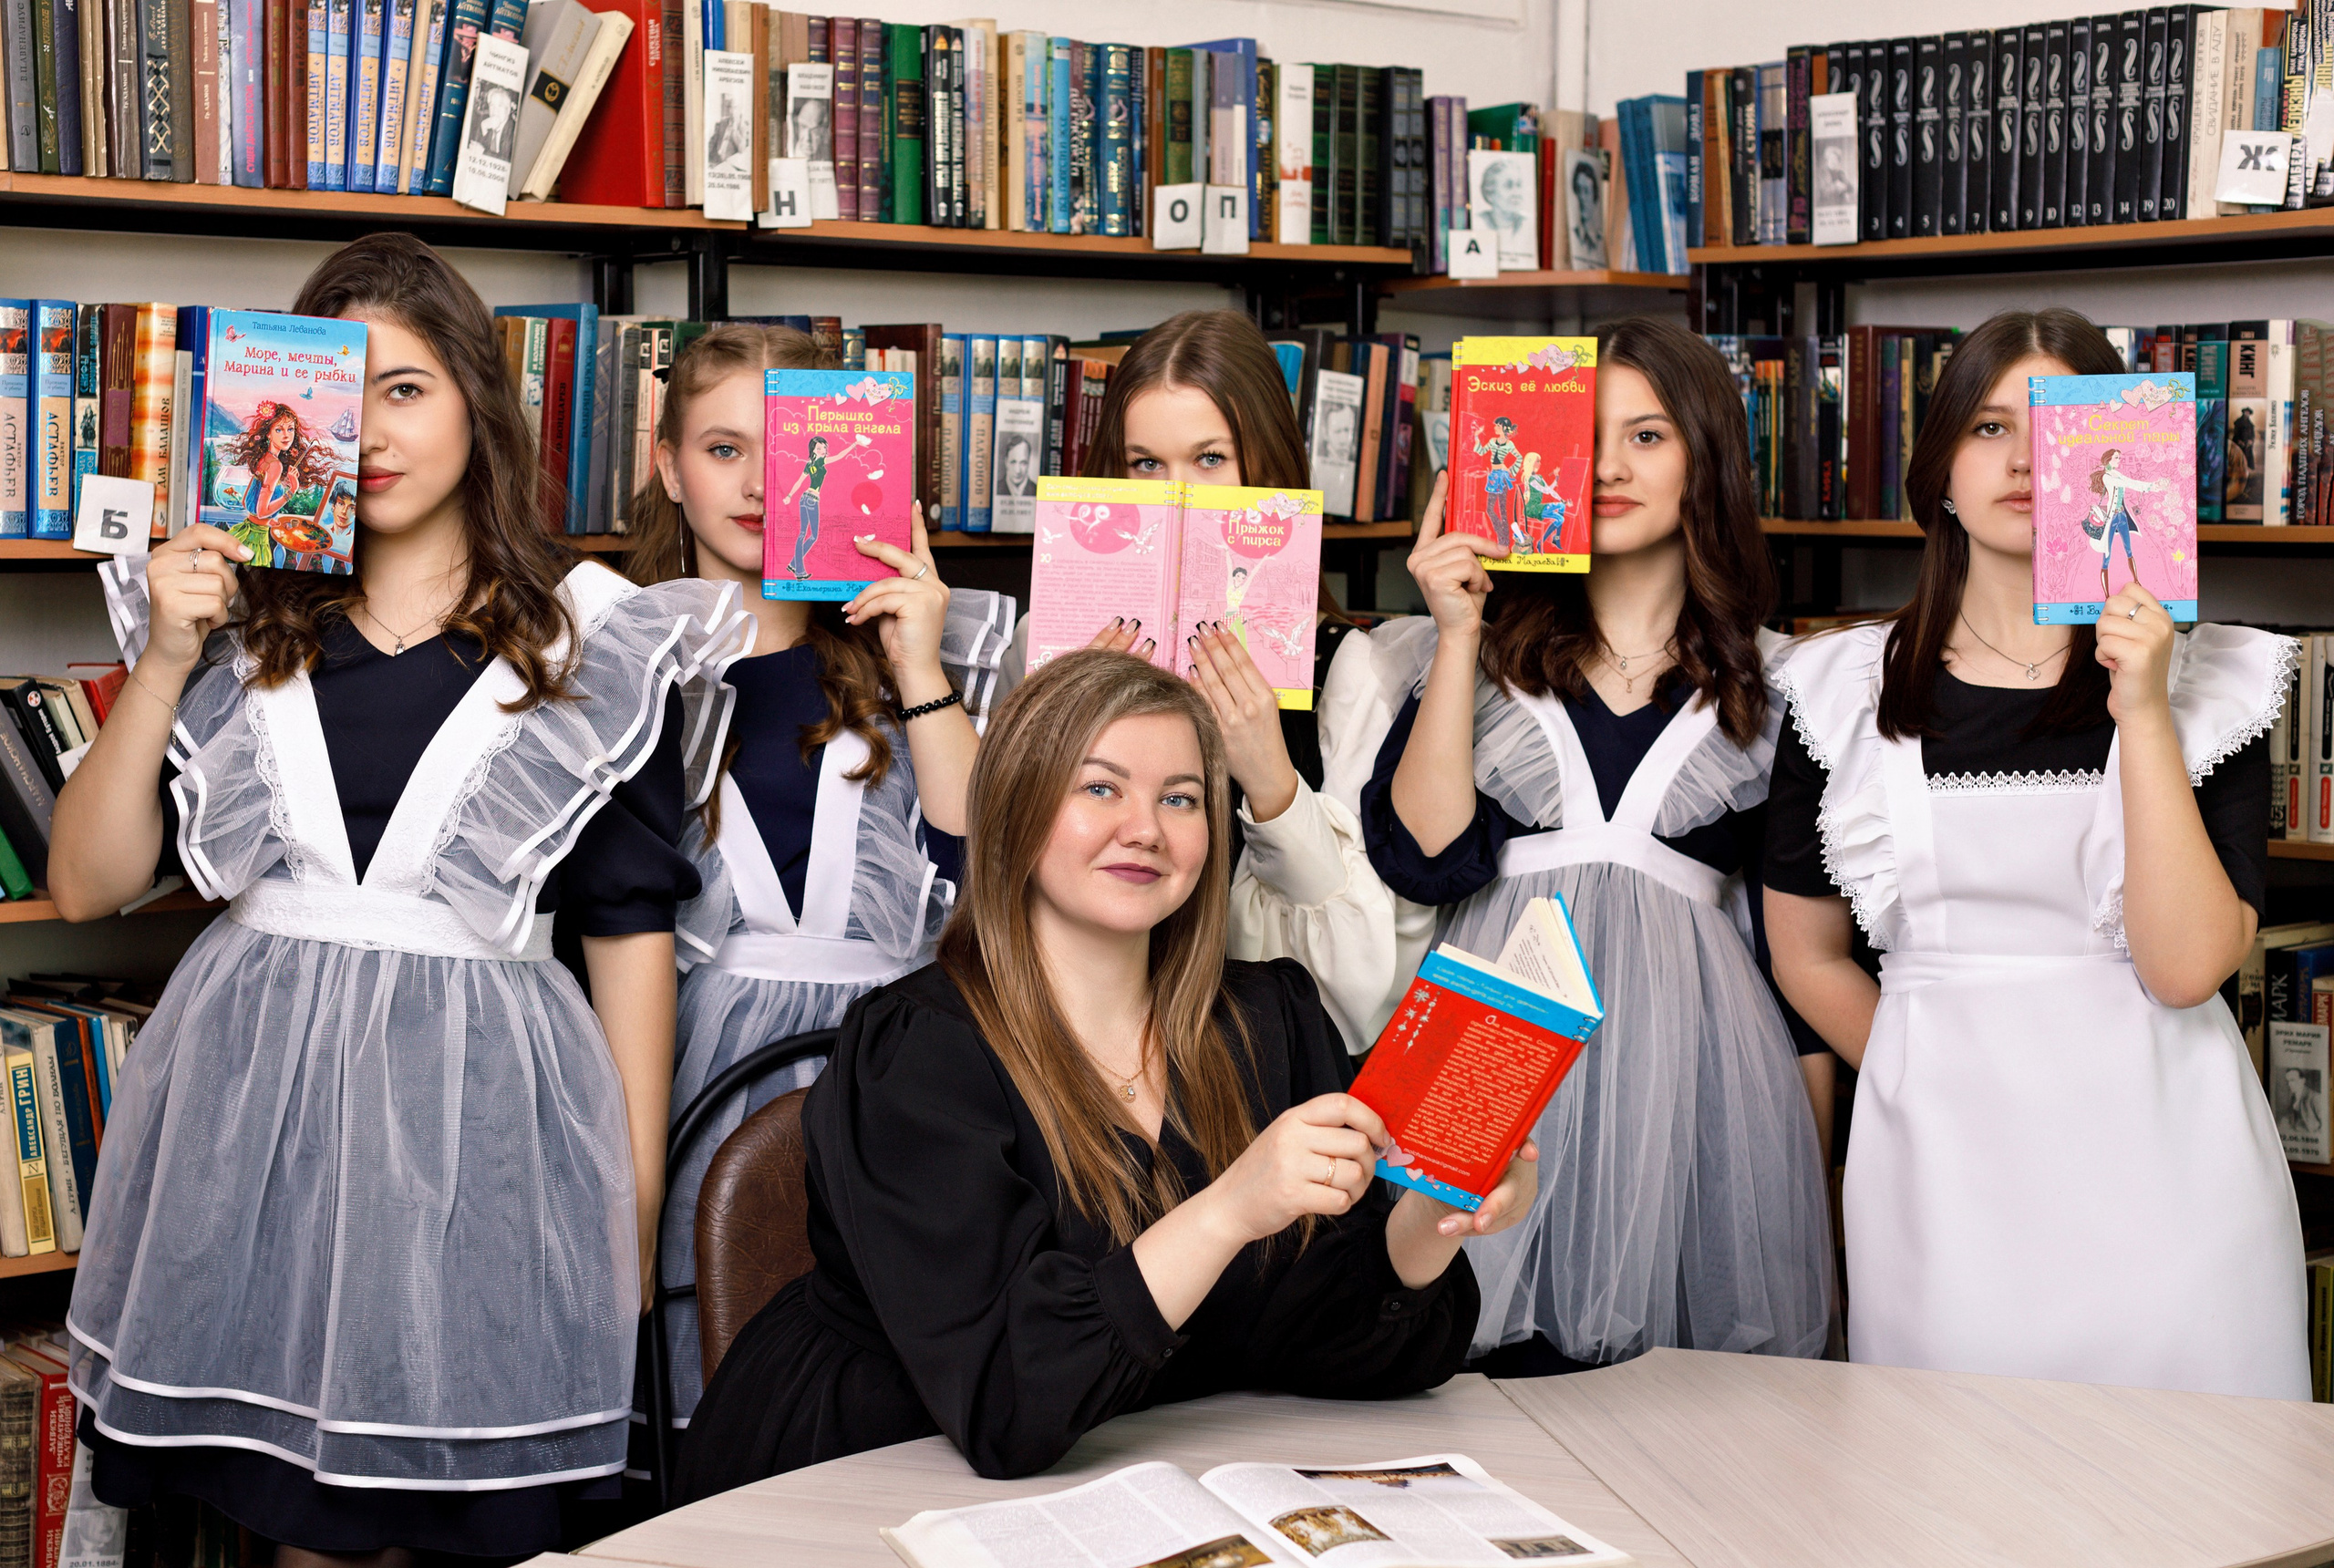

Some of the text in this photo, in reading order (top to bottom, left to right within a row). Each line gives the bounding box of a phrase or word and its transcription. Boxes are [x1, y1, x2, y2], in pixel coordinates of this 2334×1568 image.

[2237, 144, 2280, 172] Ж
[774, 191, 796, 216] Н
[1170, 200, 1189, 223] О
[1220, 195, 1236, 219] П
[1465, 239, 1482, 254] А
[252, 321, 326, 335] Татьяна Леванова
[243, 346, 337, 367] Море, мечты,
[2239, 344, 2256, 378] КИНГ
[223, 360, 356, 384] Марина и ее рыбки
[1467, 376, 1586, 395] Эскиз её любви
[808, 405, 873, 423] Перышко
[2088, 414, 2150, 433] Секрет
[158, 397, 170, 459] БАЛАШОВ
[783, 422, 902, 435] из крыла ангела
[2058, 431, 2180, 448] идеальной пары
[3, 412, 16, 499] АСТАФЬЕВ
[46, 410, 59, 498] АСТАФЬЕВ
[976, 428, 985, 496] ПЛАТОНОВ
[2296, 389, 2309, 521] ГОРОД ПАДШИХ АНГЕЛОВ
[100, 508, 129, 540] Б
[1227, 519, 1285, 535] Прыжок
[1227, 535, 1282, 547] с пирса
[1516, 555, 1555, 567] Мазаева
[1466, 1026, 1496, 1040] магазинах
[1505, 1041, 1525, 1052] никто
[1484, 1040, 1513, 1054] внимания
[1517, 1039, 1548, 1055] продавцы
[1455, 1042, 1477, 1053] словно
[1477, 1050, 1506, 1065] смотрит
[1459, 1037, 1545, 1074] скромную Карина
[1449, 1053, 1525, 1087] интересное происходит
[1436, 1074, 1522, 1111] прекрасной романтической
[1442, 1064, 1460, 1073] никак
[1472, 1076, 1507, 1092] получается
[1508, 1090, 1528, 1101] выйти
[1473, 1082, 1494, 1094] стать
[1497, 1092, 1525, 1106] героиней
[15, 1068, 38, 1158] АЛЕКСАНДР ГРИН
[52, 1100, 61, 1116] ПО
[1416, 1107, 1434, 1117] какая
[1435, 1114, 1450, 1123] роль
[1450, 1120, 1469, 1130] тогда
[1423, 1096, 1508, 1132] заветное желание может
[1454, 1096, 1483, 1109] считают
[1485, 1108, 1514, 1122] чудесным
[1487, 1101, 1507, 1112] Новый
[1420, 1121, 1444, 1133] бывают
[1453, 1134, 1475, 1146] только
[1449, 1126, 1464, 1135] Ведь
[1492, 1117, 1512, 1128] время
[1400, 1132, 1434, 1149] настоящее
[1403, 1128, 1488, 1164] тайное присутствие самое
